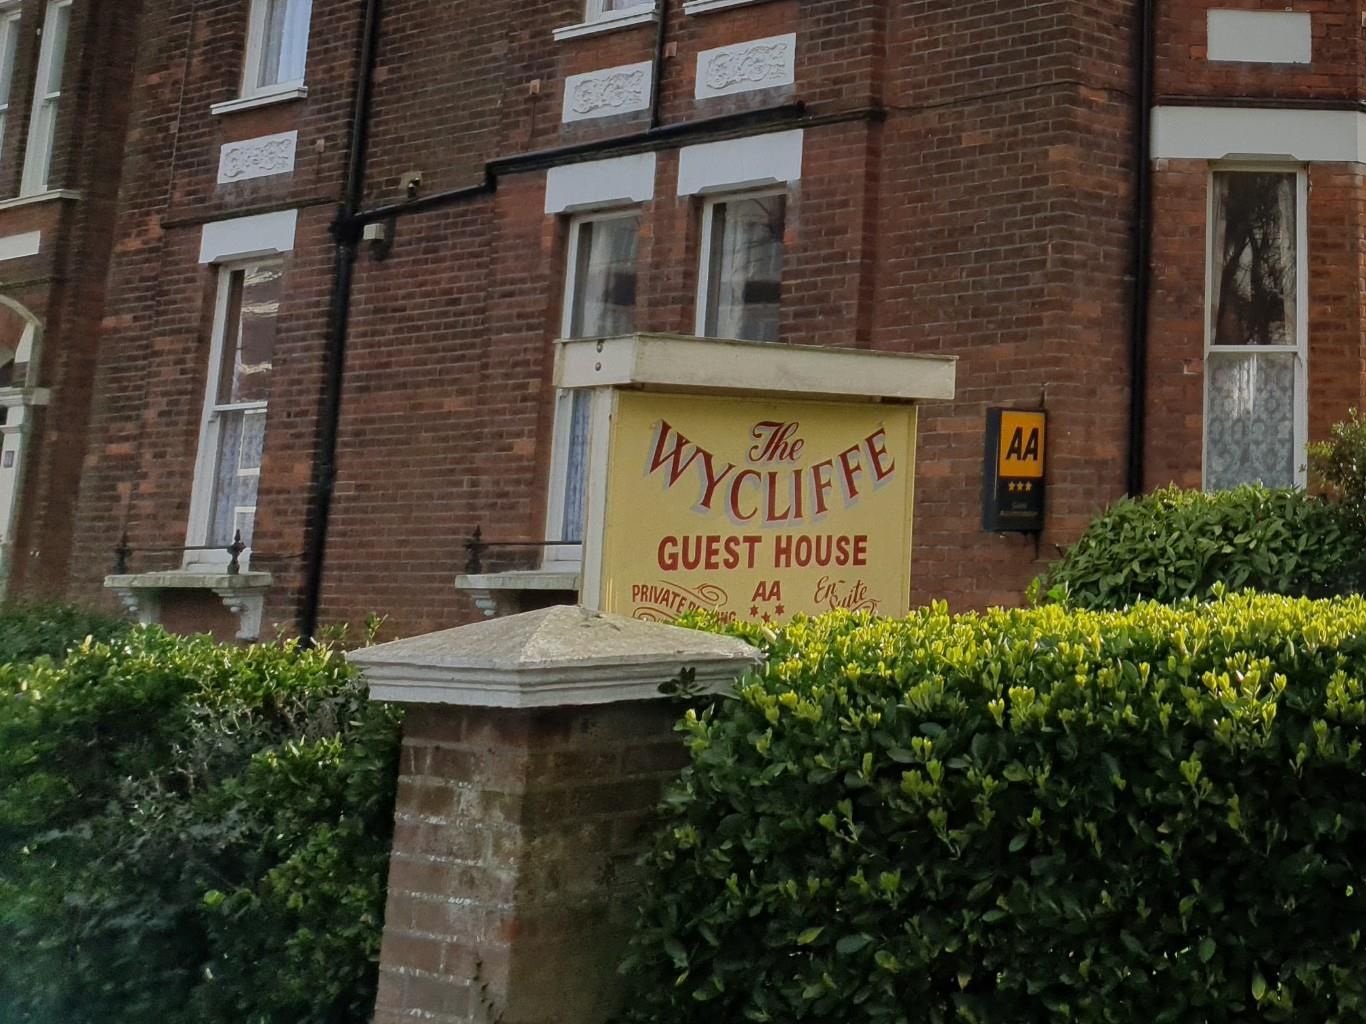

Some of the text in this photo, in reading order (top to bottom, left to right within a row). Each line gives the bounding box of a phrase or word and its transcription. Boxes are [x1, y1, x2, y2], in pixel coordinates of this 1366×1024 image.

[749, 421, 804, 462] The
[1005, 426, 1040, 461] AA
[649, 418, 896, 522] WYCLIFFE
[657, 534, 868, 571] GUEST HOUSE
[632, 584, 687, 614] PRIVATE
[751, 580, 781, 602] AA
[829, 579, 868, 612] Suite
